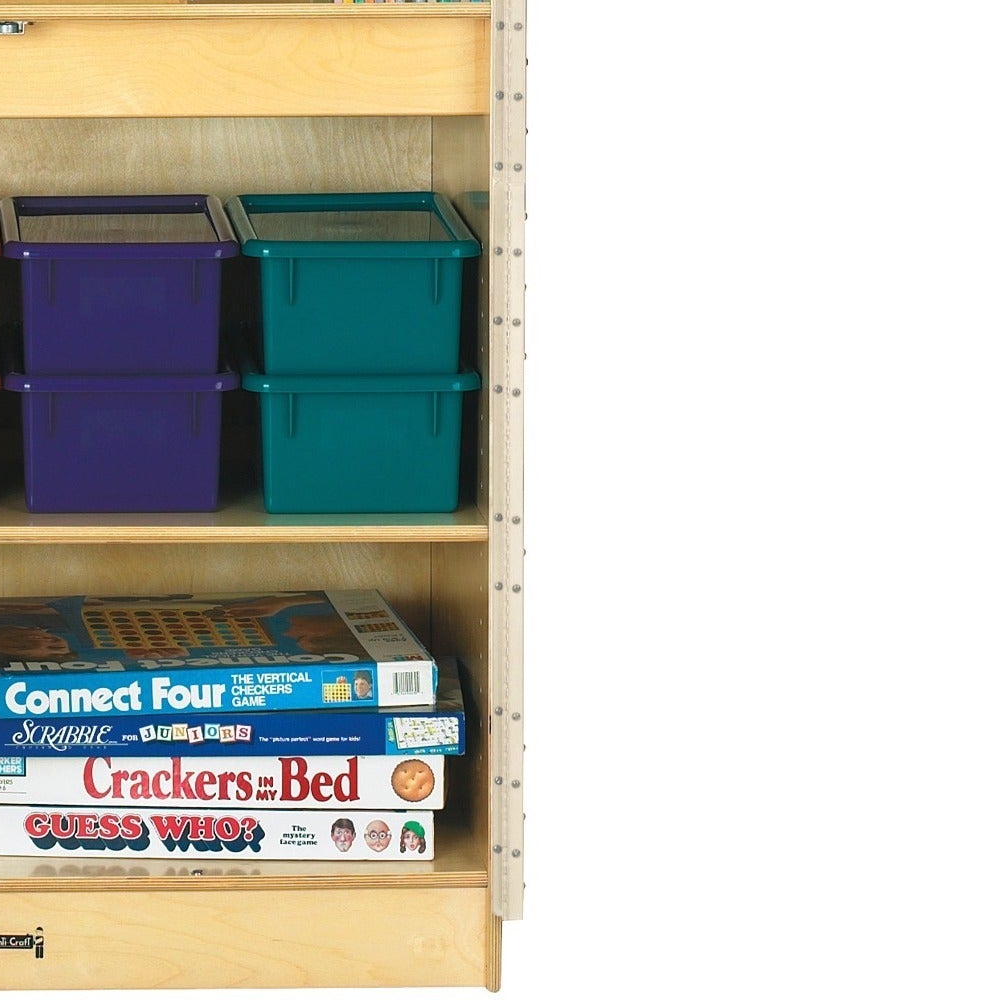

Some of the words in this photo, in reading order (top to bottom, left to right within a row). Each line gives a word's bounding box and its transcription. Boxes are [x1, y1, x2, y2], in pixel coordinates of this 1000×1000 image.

[231, 674, 254, 685] THE
[257, 672, 312, 684] VERTICAL
[5, 680, 141, 715] Connect
[151, 677, 226, 710] Four
[231, 684, 293, 696] CHECKERS
[231, 696, 266, 707] GAME
[12, 719, 114, 751] SCRABBLE
[144, 726, 249, 740] JUNIORS
[83, 757, 253, 801] Crackers
[258, 777, 274, 788] IN
[278, 756, 360, 802] Bed
[256, 790, 278, 801] MY
[24, 812, 144, 841] GUESS
[150, 814, 260, 843] WHO?
[283, 832, 316, 840] mystery
